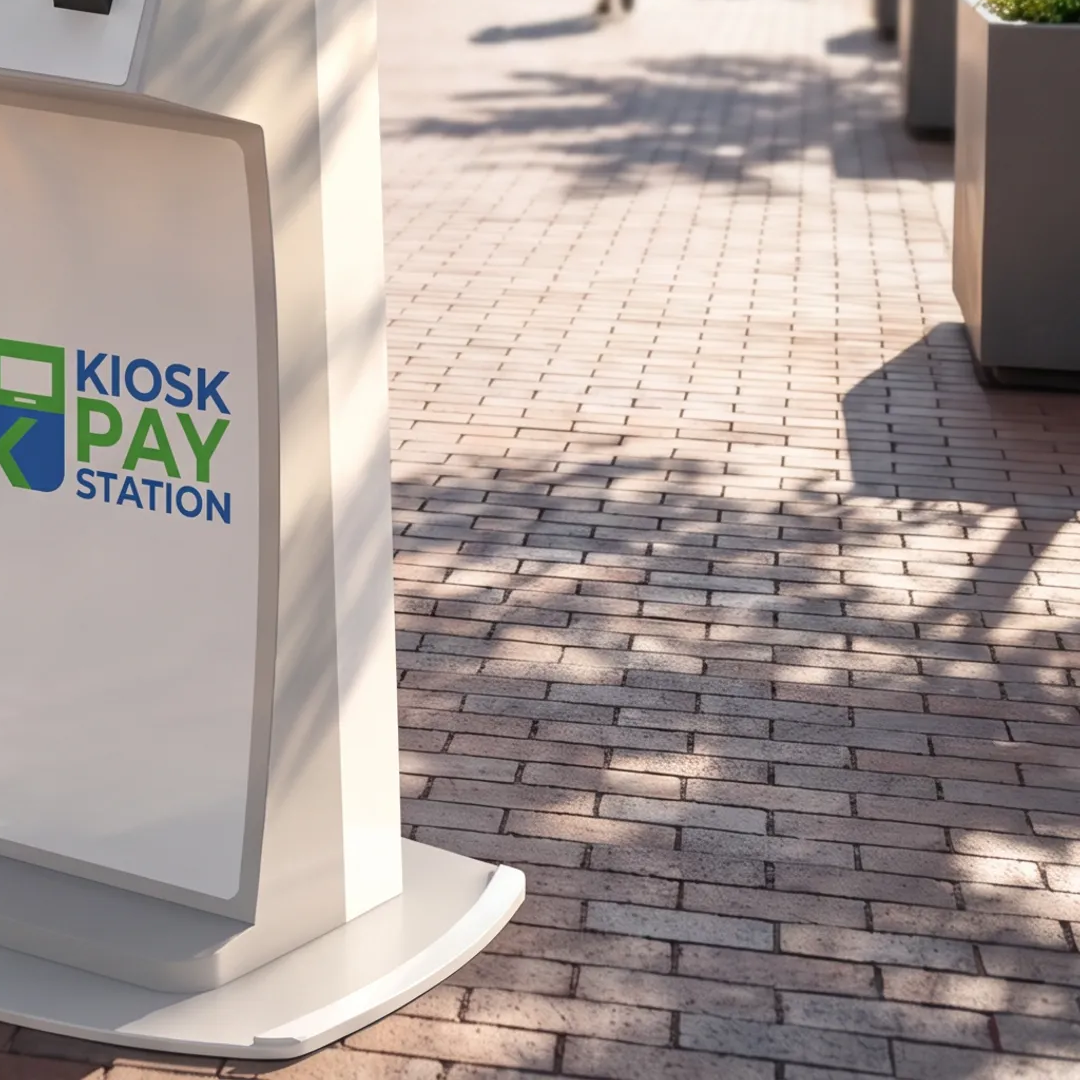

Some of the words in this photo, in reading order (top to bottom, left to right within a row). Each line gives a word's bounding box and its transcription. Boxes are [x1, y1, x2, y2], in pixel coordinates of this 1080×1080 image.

[76, 349, 231, 415] KIOSK
[76, 396, 231, 483] PAY
[76, 467, 231, 525] STATION
